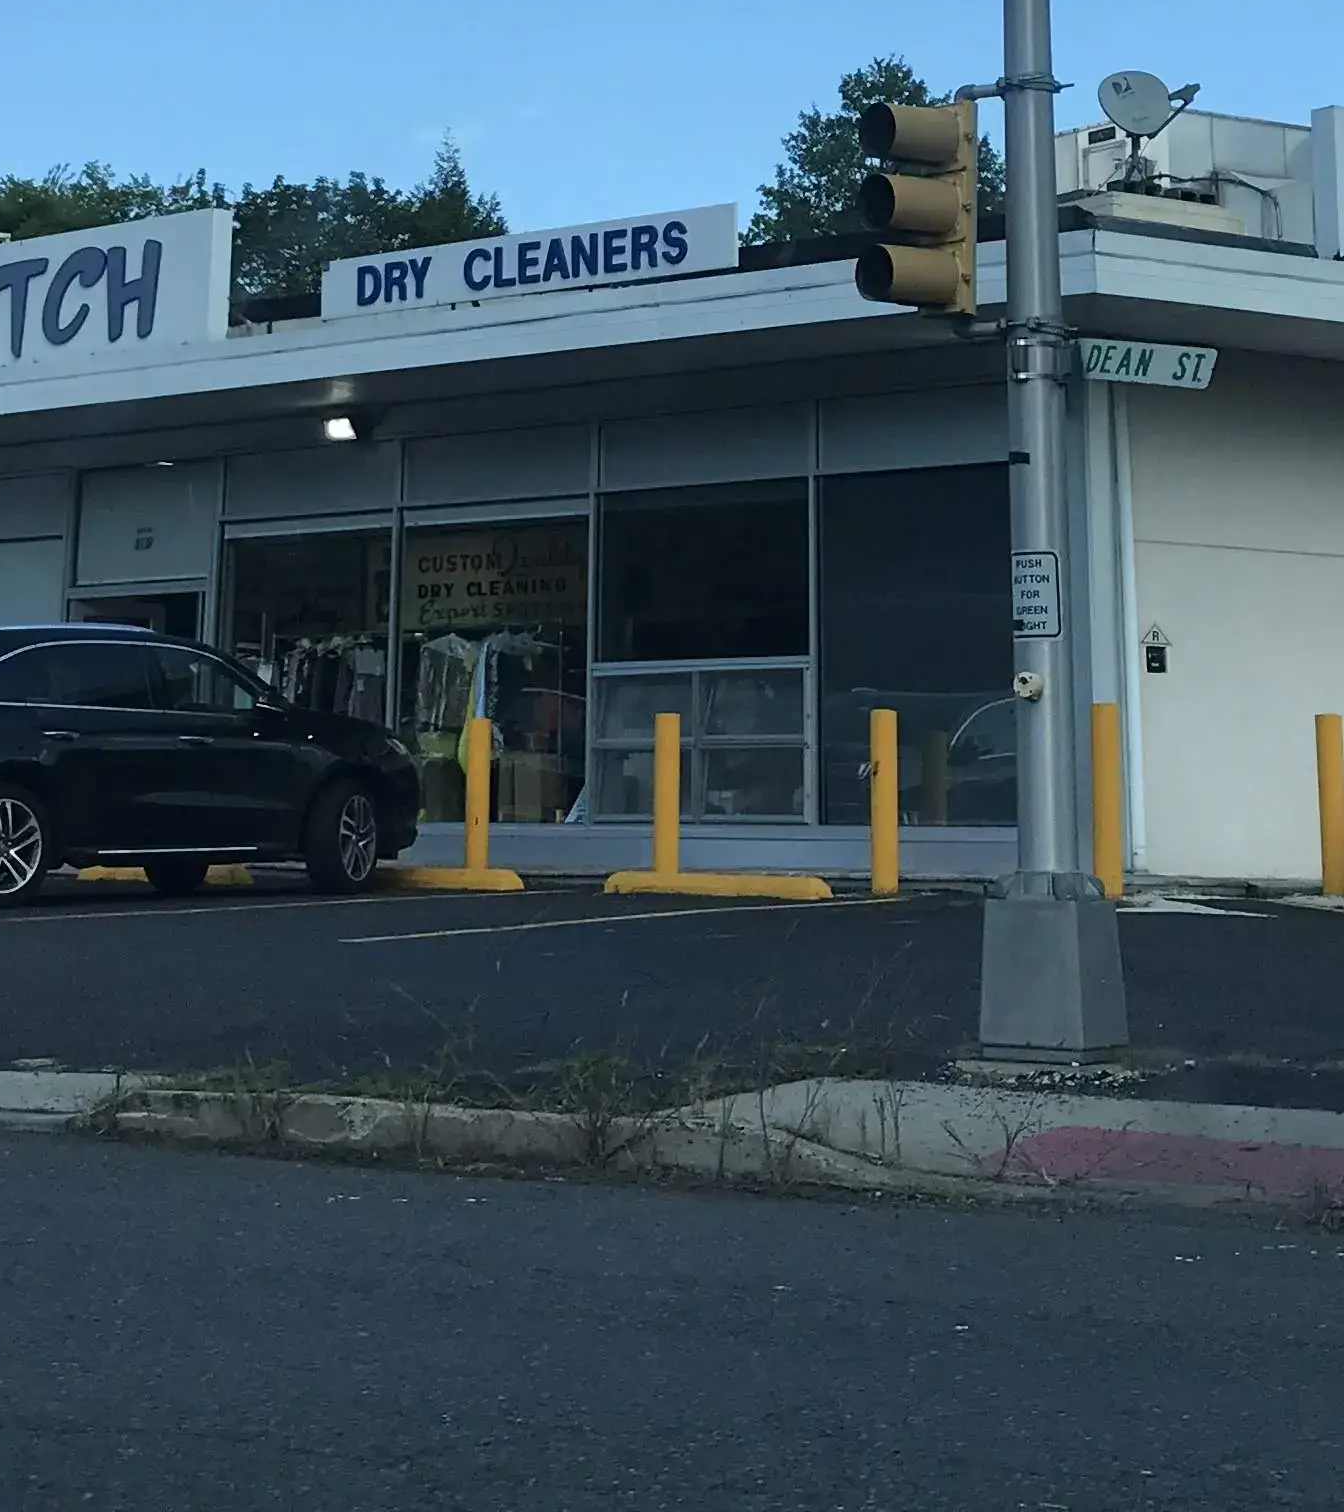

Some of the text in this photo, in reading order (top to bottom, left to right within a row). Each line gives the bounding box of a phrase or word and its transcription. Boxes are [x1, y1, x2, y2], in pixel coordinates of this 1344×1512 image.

[356, 220, 689, 307] DRY CLEANERS
[1086, 344, 1154, 378] DEAN
[1016, 559, 1042, 568] PUSH
[417, 576, 567, 599] DRY CLEANING
[1020, 590, 1040, 600] FOR
[1016, 605, 1048, 615] GREEN
